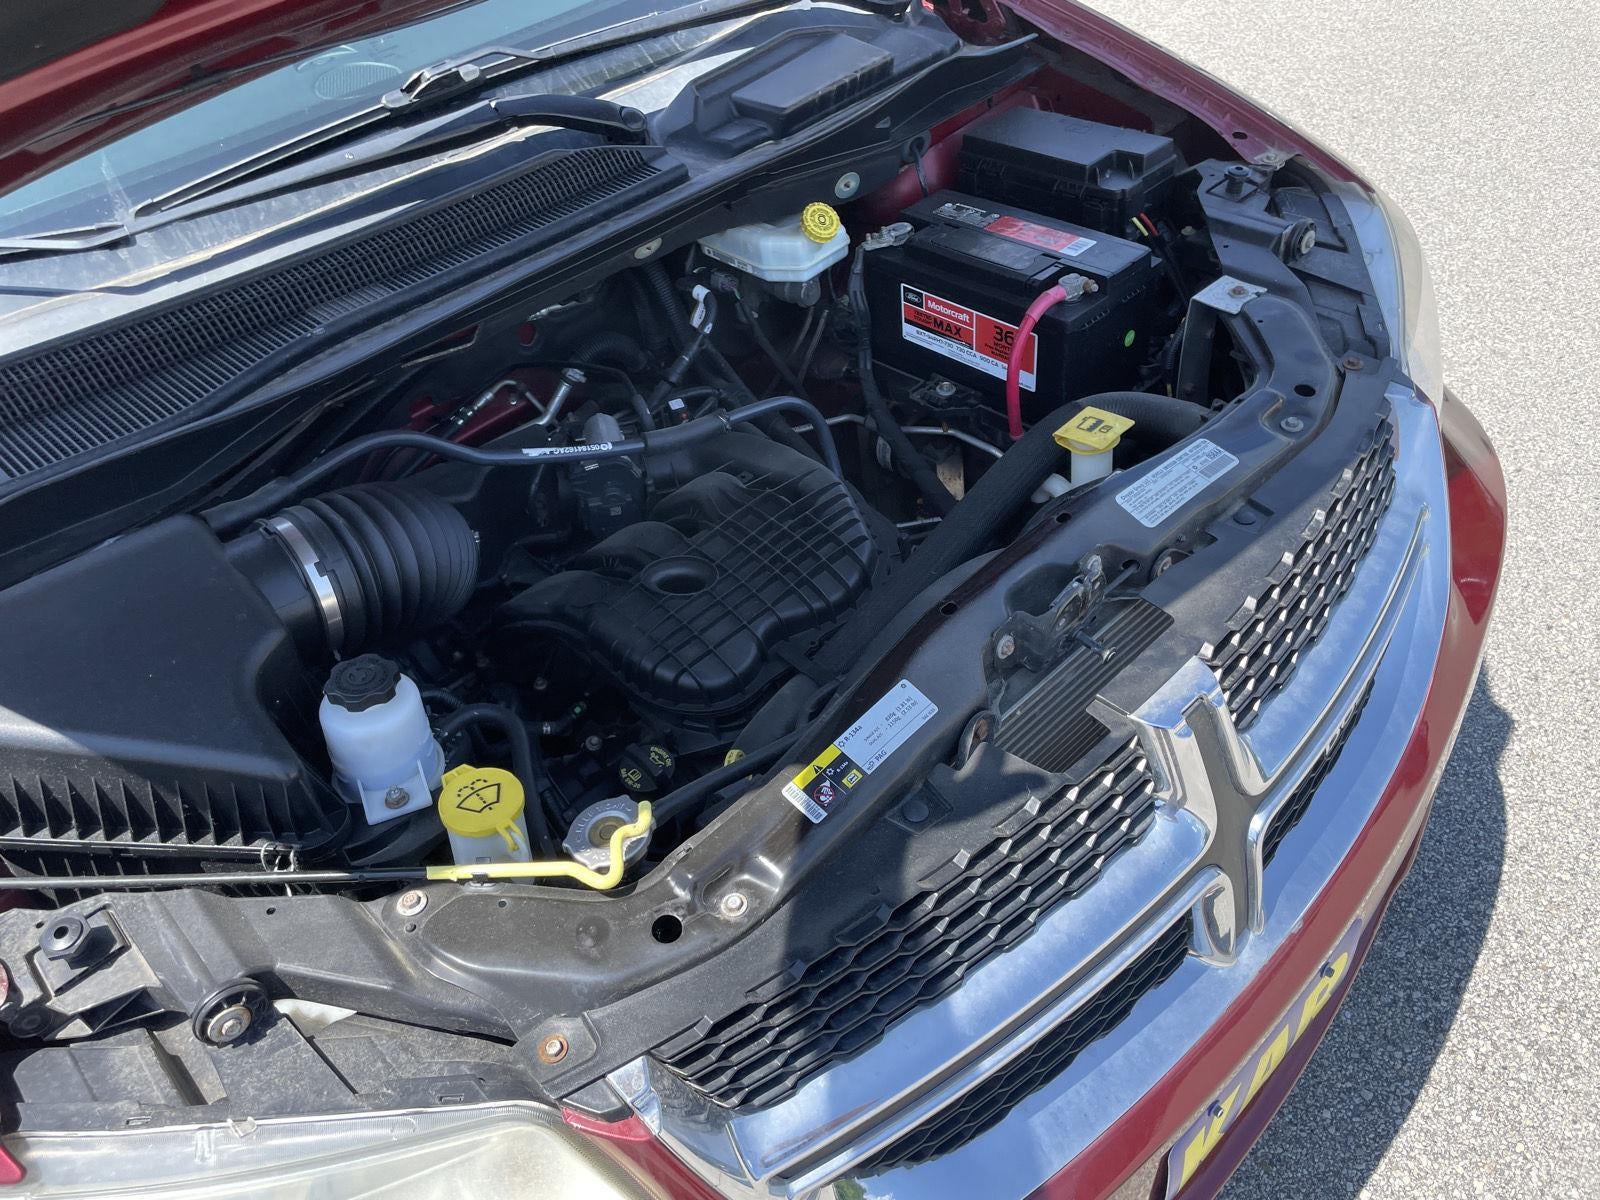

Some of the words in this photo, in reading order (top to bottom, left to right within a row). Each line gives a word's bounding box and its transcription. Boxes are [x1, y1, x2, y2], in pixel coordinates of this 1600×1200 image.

[928, 300, 970, 323] Motorcraft
[934, 318, 962, 338] MAX
[994, 326, 1014, 344] 36
[966, 350, 978, 358] CCA
[990, 358, 999, 368] CA
[844, 725, 862, 742] R-134a
[875, 750, 888, 762] PAG
